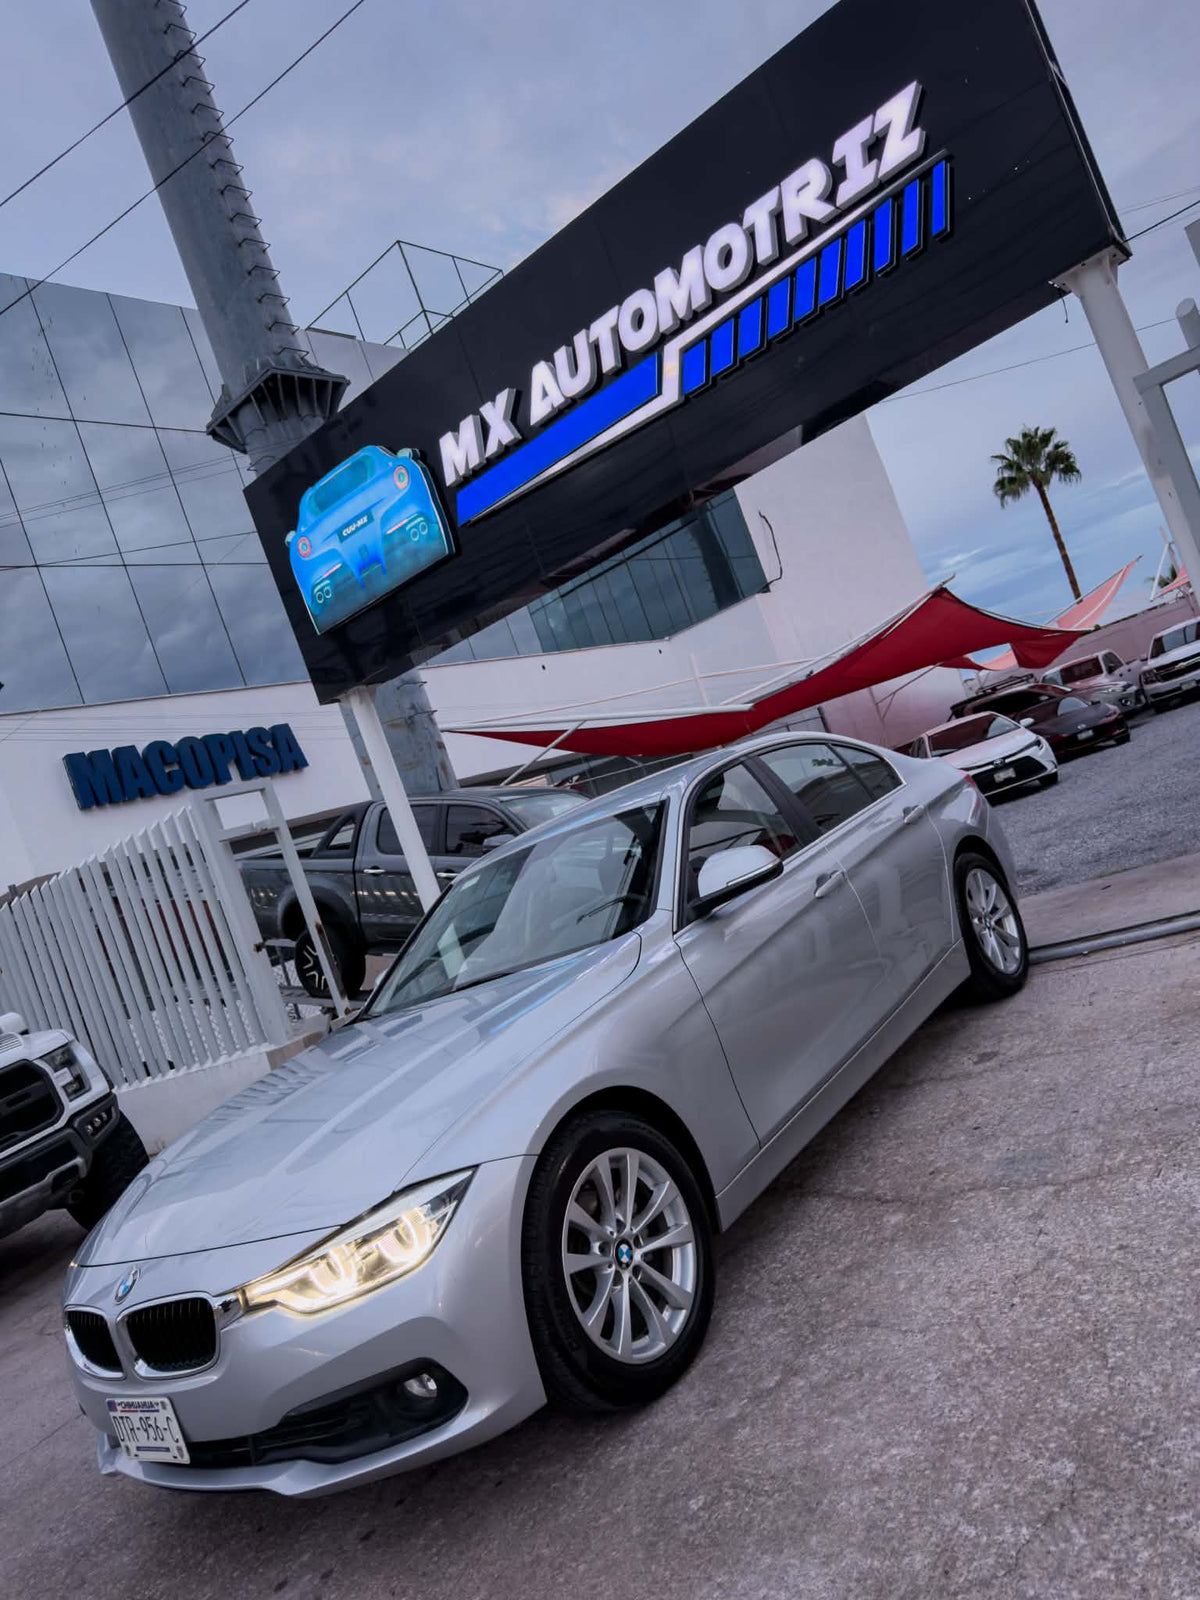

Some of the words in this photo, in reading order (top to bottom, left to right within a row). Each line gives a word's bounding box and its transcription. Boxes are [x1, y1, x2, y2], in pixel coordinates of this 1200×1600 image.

[438, 388, 522, 486] MX
[530, 80, 926, 427] AUTOMOTRIZ
[63, 723, 309, 811] MACOPISA
